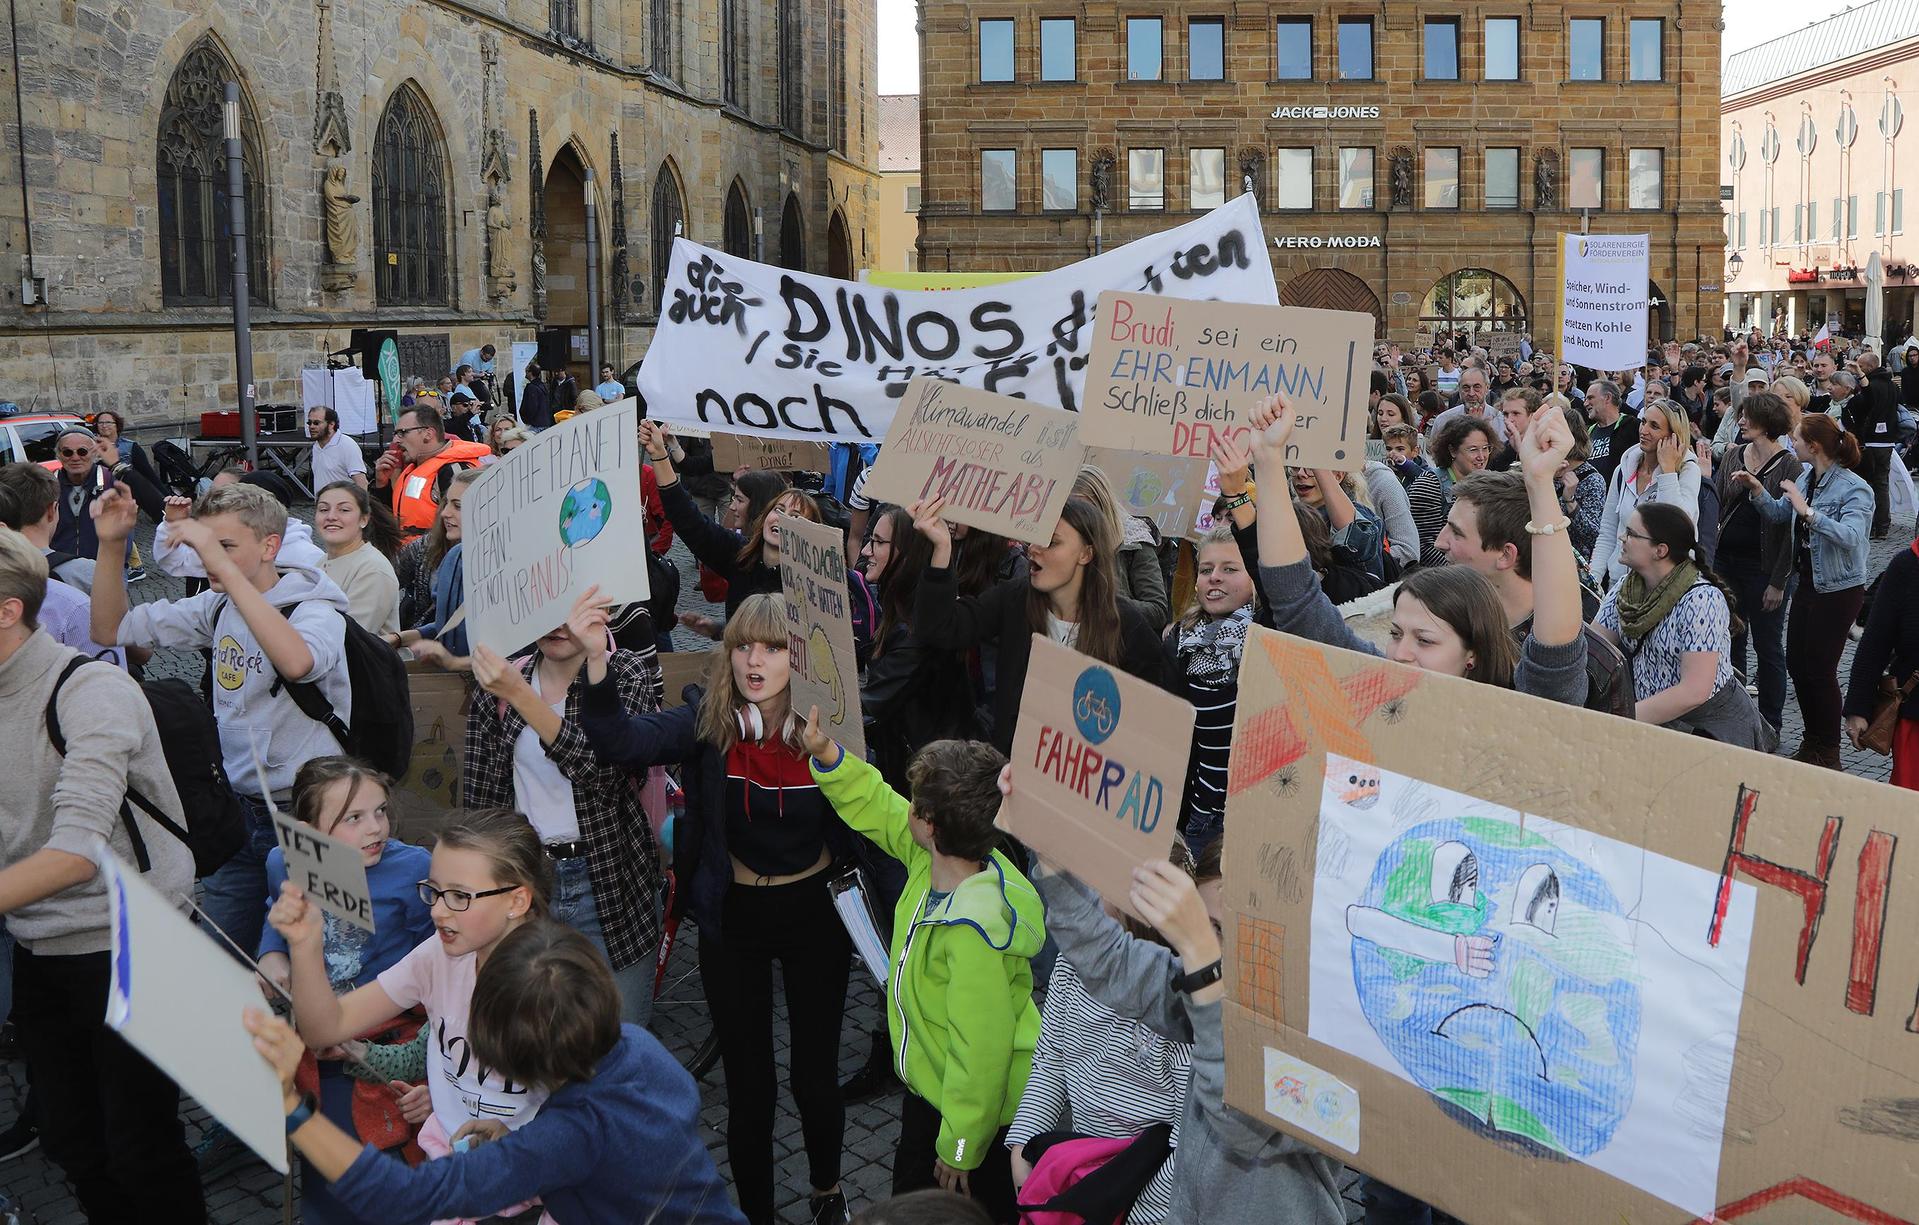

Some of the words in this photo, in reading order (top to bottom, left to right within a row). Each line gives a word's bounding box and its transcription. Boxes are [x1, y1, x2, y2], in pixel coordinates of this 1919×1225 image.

[1271, 106, 1312, 118] JACK
[1328, 106, 1380, 118] JONES
[1274, 236, 1322, 248] VERO
[1327, 236, 1381, 248] MODA
[1590, 241, 1645, 249] SOLARENERGIE
[1566, 279, 1593, 294] Speicher,
[1595, 283, 1631, 294] Wind-
[779, 274, 1027, 364] DINOS
[1576, 299, 1645, 311] Sonnenstrom
[1110, 300, 1180, 352] Brudi,
[1198, 327, 1239, 349] sei
[1260, 334, 1298, 356] ein
[1564, 318, 1593, 332] ersetzen
[1595, 321, 1632, 333] Kohle
[1576, 337, 1604, 349] Atom!
[696, 383, 873, 438] noch
[910, 382, 1030, 438] Klimawandel
[1195, 393, 1235, 422] dich
[505, 443, 543, 513] THE
[545, 409, 632, 493] PLANET
[760, 452, 793, 468] DYING!
[1020, 448, 1044, 468] als
[470, 517, 513, 586] CLEAN!
[487, 568, 505, 609] NOT
[506, 545, 575, 625] URANUS!
[229, 647, 263, 674] Rock
[1034, 726, 1163, 834] FAHRRAD
[307, 871, 370, 922] ERDE
